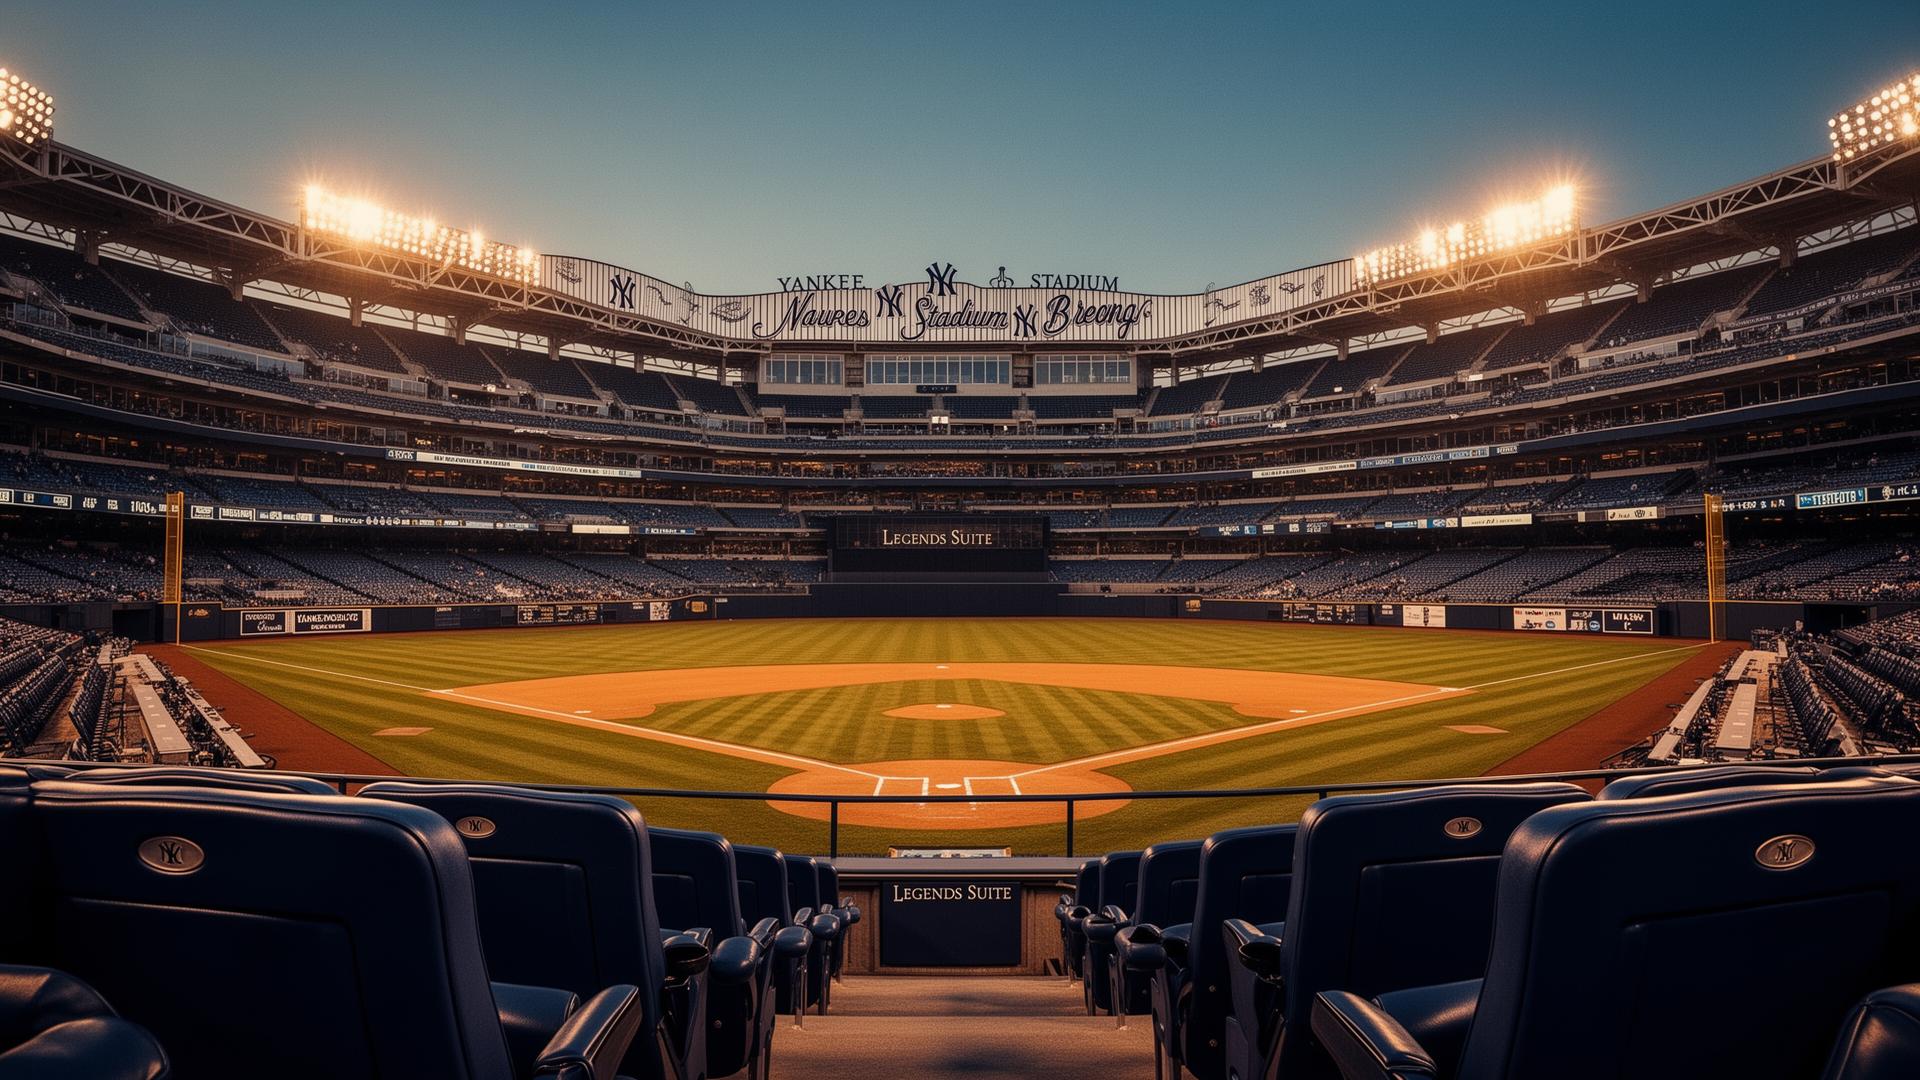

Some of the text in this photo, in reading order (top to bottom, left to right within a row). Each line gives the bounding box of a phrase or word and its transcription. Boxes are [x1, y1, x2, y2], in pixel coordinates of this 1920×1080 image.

[609, 274, 637, 310] NY
[777, 273, 1120, 293] YANKEE STADIUM
[925, 261, 958, 297] NY
[876, 284, 904, 318] NY
[900, 293, 1009, 341] Stadium
[1013, 303, 1040, 338] NY
[882, 528, 993, 546] LEGENDS SUITE
[893, 884, 1013, 902] LEGENDS SUITE
